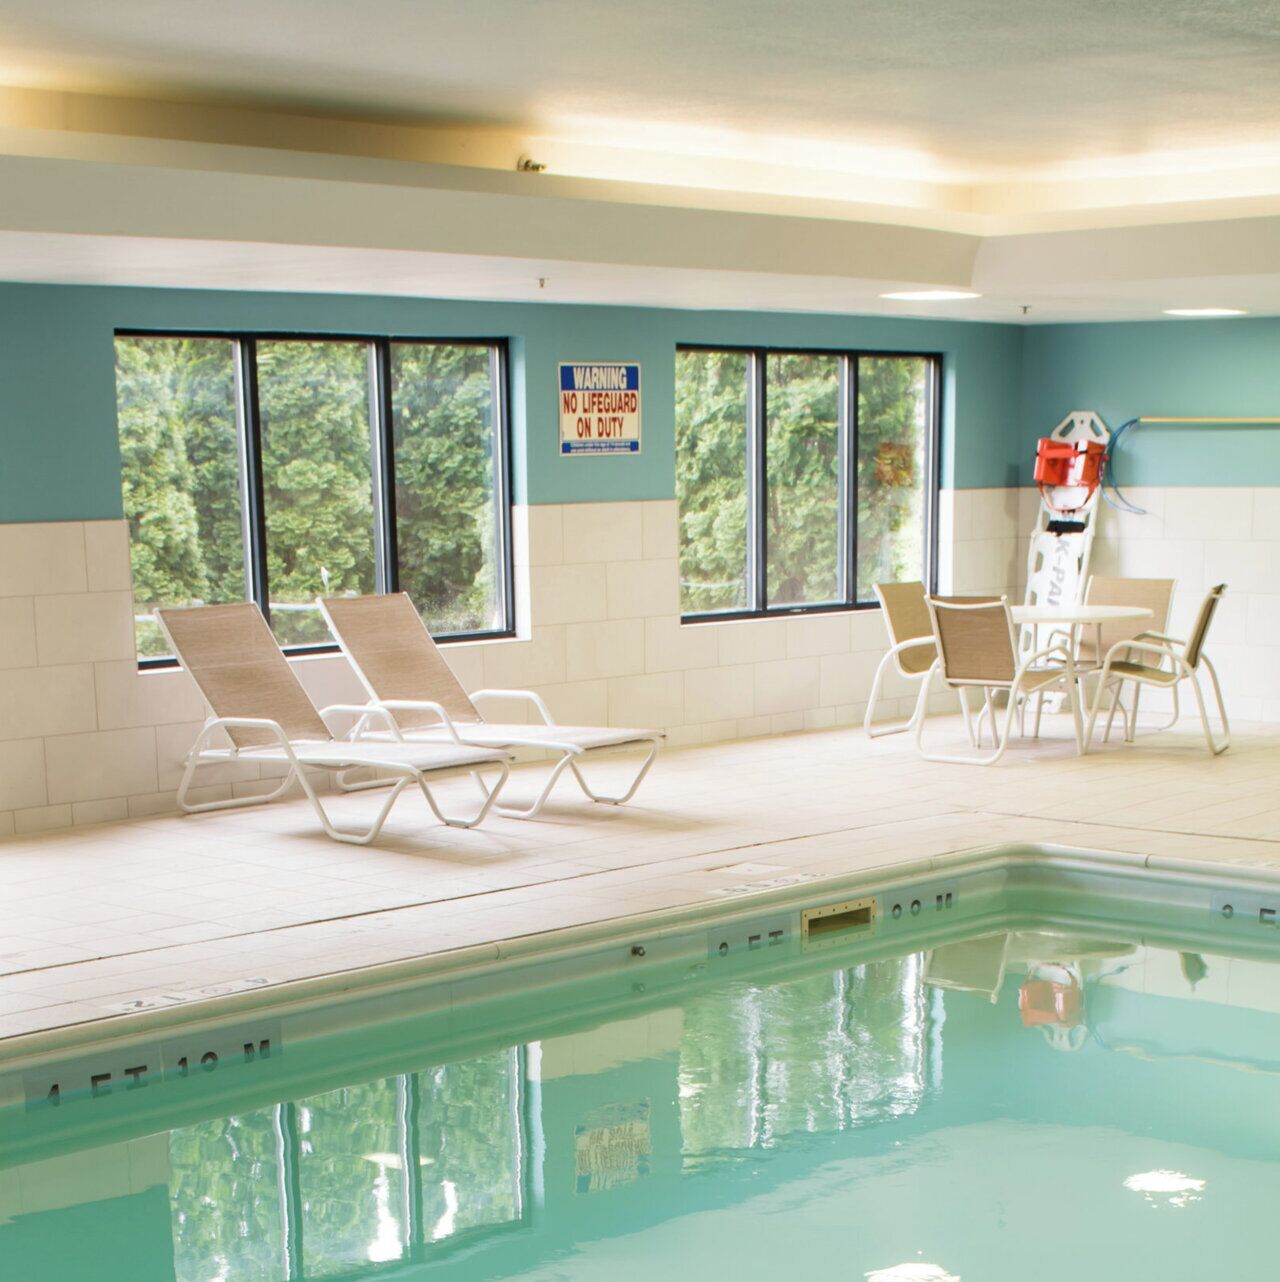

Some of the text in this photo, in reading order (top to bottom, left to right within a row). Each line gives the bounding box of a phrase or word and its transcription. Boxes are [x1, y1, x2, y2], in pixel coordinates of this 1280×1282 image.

[573, 366, 627, 390] WARNING
[563, 392, 637, 413] NO LIFEGUARD
[577, 416, 624, 438] ON DUTY
